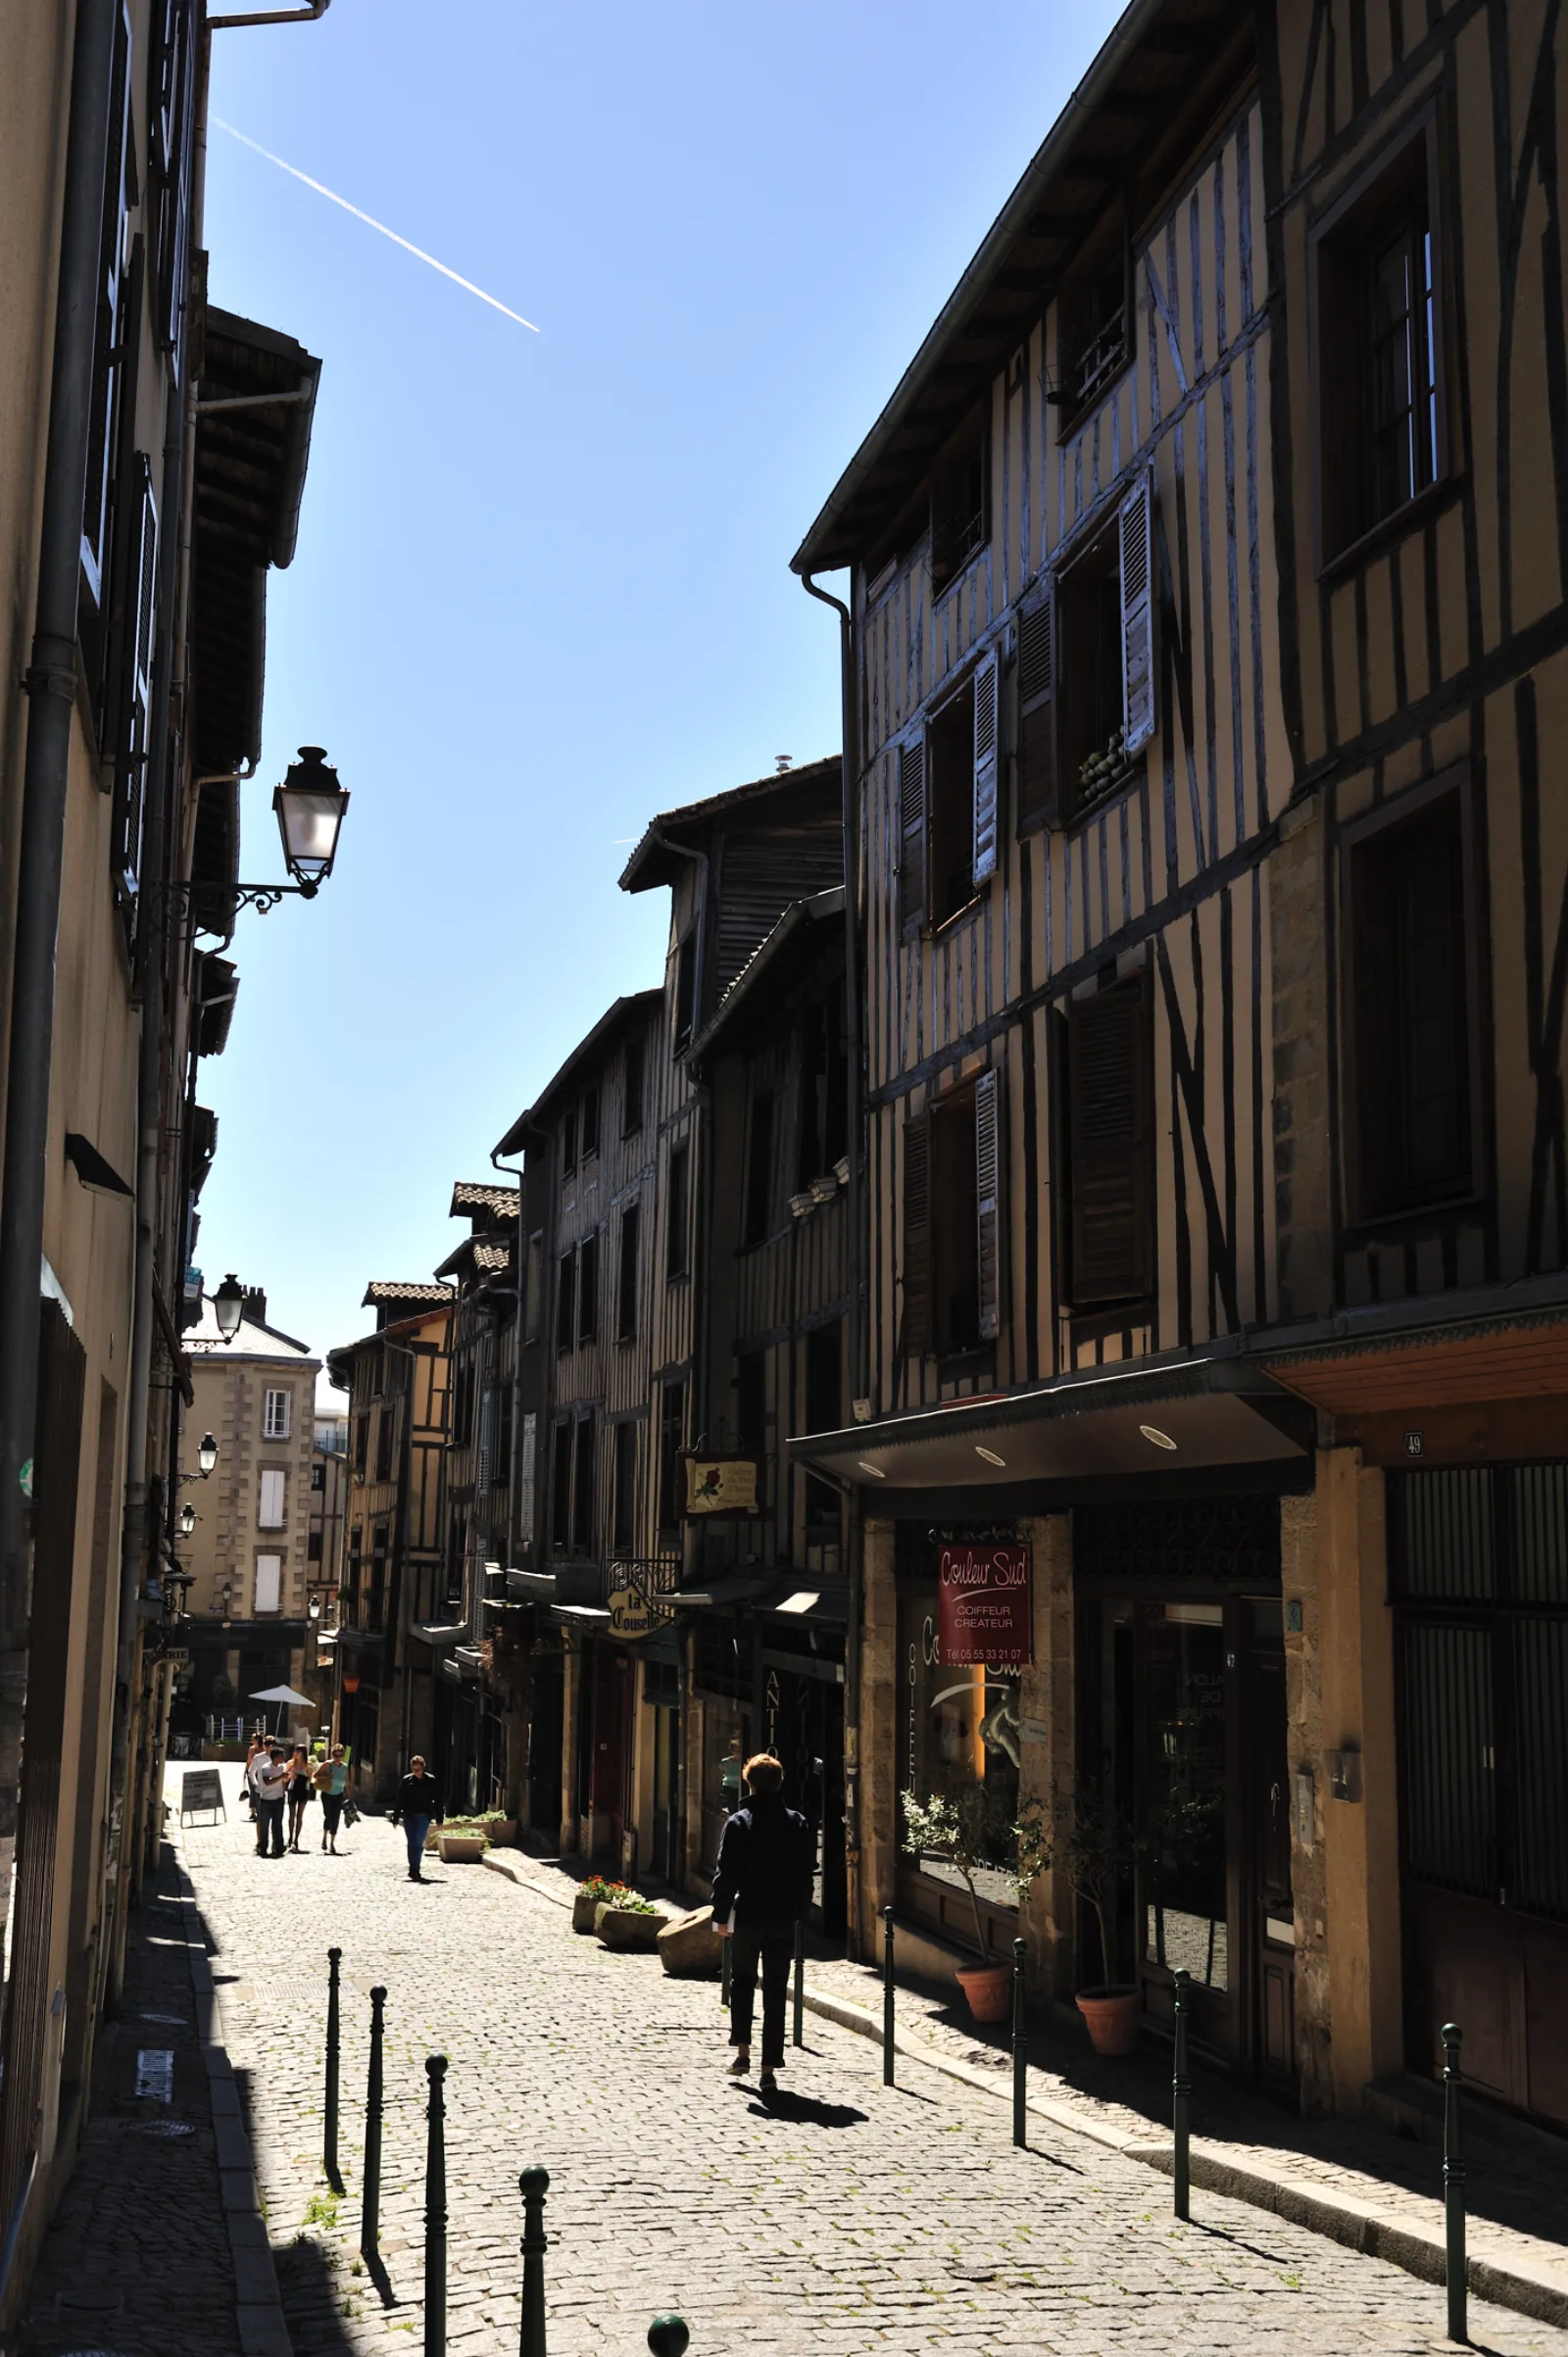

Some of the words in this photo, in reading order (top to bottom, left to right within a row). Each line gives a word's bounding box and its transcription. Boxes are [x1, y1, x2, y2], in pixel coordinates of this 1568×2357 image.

[1408, 1436, 1421, 1453] 49
[941, 1551, 990, 1586] Couleur
[993, 1551, 1026, 1586] Sud
[629, 1593, 641, 1610] la
[956, 1605, 1010, 1615] COIFFEUR
[954, 1618, 1013, 1628] CREATEUR
[946, 1648, 958, 1659] Tél
[960, 1649, 971, 1659] 05
[973, 1649, 984, 1659] 55
[986, 1649, 997, 1659] 33
[999, 1649, 1008, 1659] 21
[1011, 1649, 1021, 1659] 07
